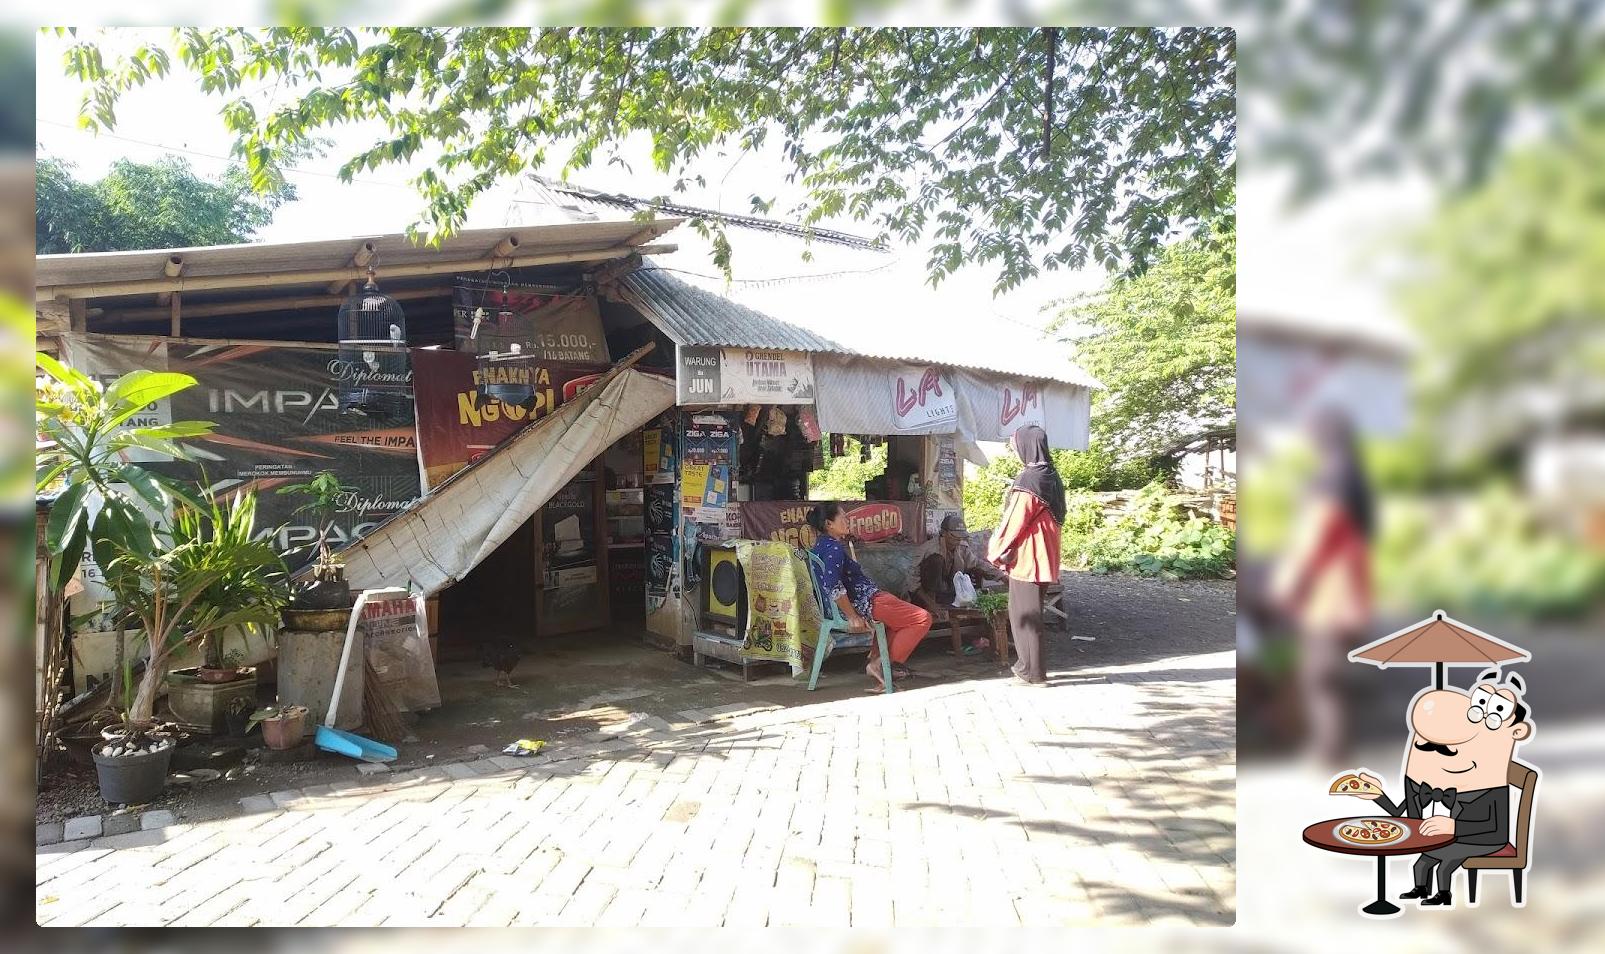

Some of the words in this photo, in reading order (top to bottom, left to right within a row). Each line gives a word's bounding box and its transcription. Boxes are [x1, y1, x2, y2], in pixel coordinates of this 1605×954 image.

[558, 350, 590, 361] BATANG
[684, 357, 717, 367] WARUNG
[327, 359, 414, 387] Diplomat
[745, 361, 788, 377] UTAMA
[688, 379, 714, 393] JUN
[896, 367, 942, 417] LA
[1002, 382, 1037, 426] LA
[119, 418, 159, 427] ANG
[334, 435, 358, 444] FEEL
[360, 436, 382, 446] THE
[384, 436, 415, 448] IMPA
[686, 430, 706, 438] ZIGA
[780, 506, 815, 524] ENAK
[771, 524, 814, 550] NGO
